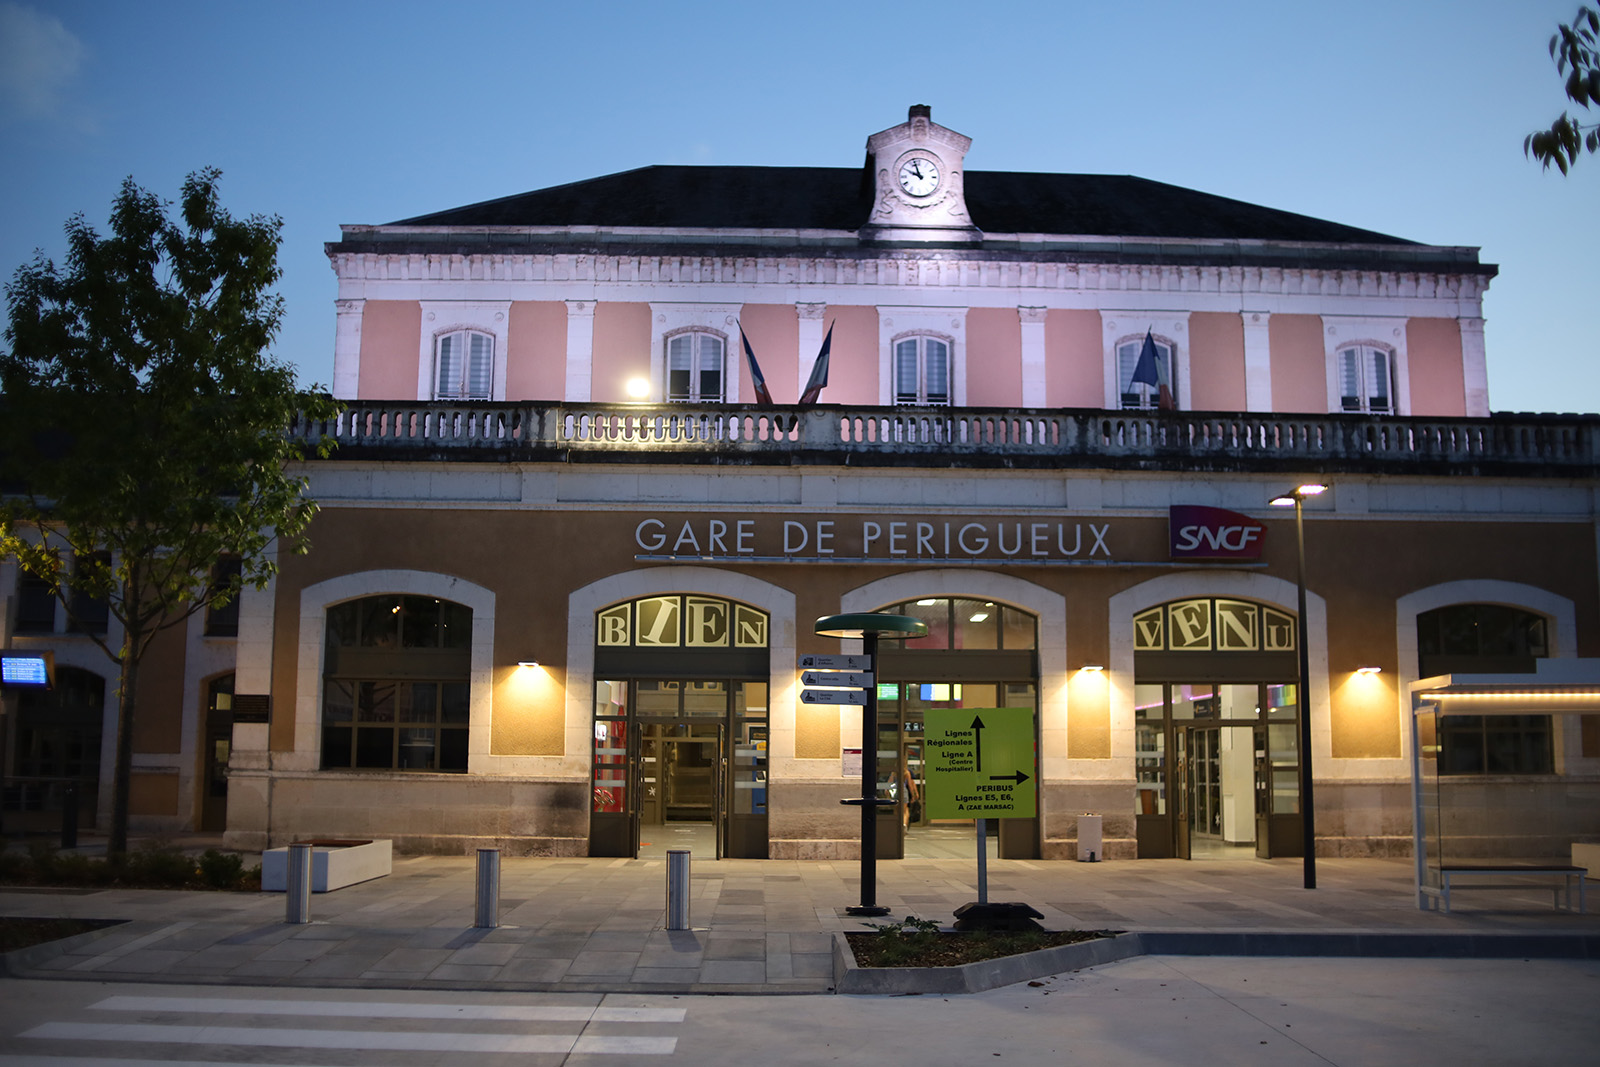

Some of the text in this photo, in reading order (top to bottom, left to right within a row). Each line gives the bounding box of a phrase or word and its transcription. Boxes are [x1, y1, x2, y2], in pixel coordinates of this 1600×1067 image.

[635, 518, 1111, 556] GARE DE PERIGUEUX
[1175, 525, 1262, 551] SNCF
[945, 730, 972, 738] Lignes
[927, 739, 972, 747] Régionales
[942, 751, 965, 759] Ligne
[955, 794, 983, 803] Lignes
[985, 794, 998, 802] E5,
[984, 803, 1014, 811] MARSAC)
